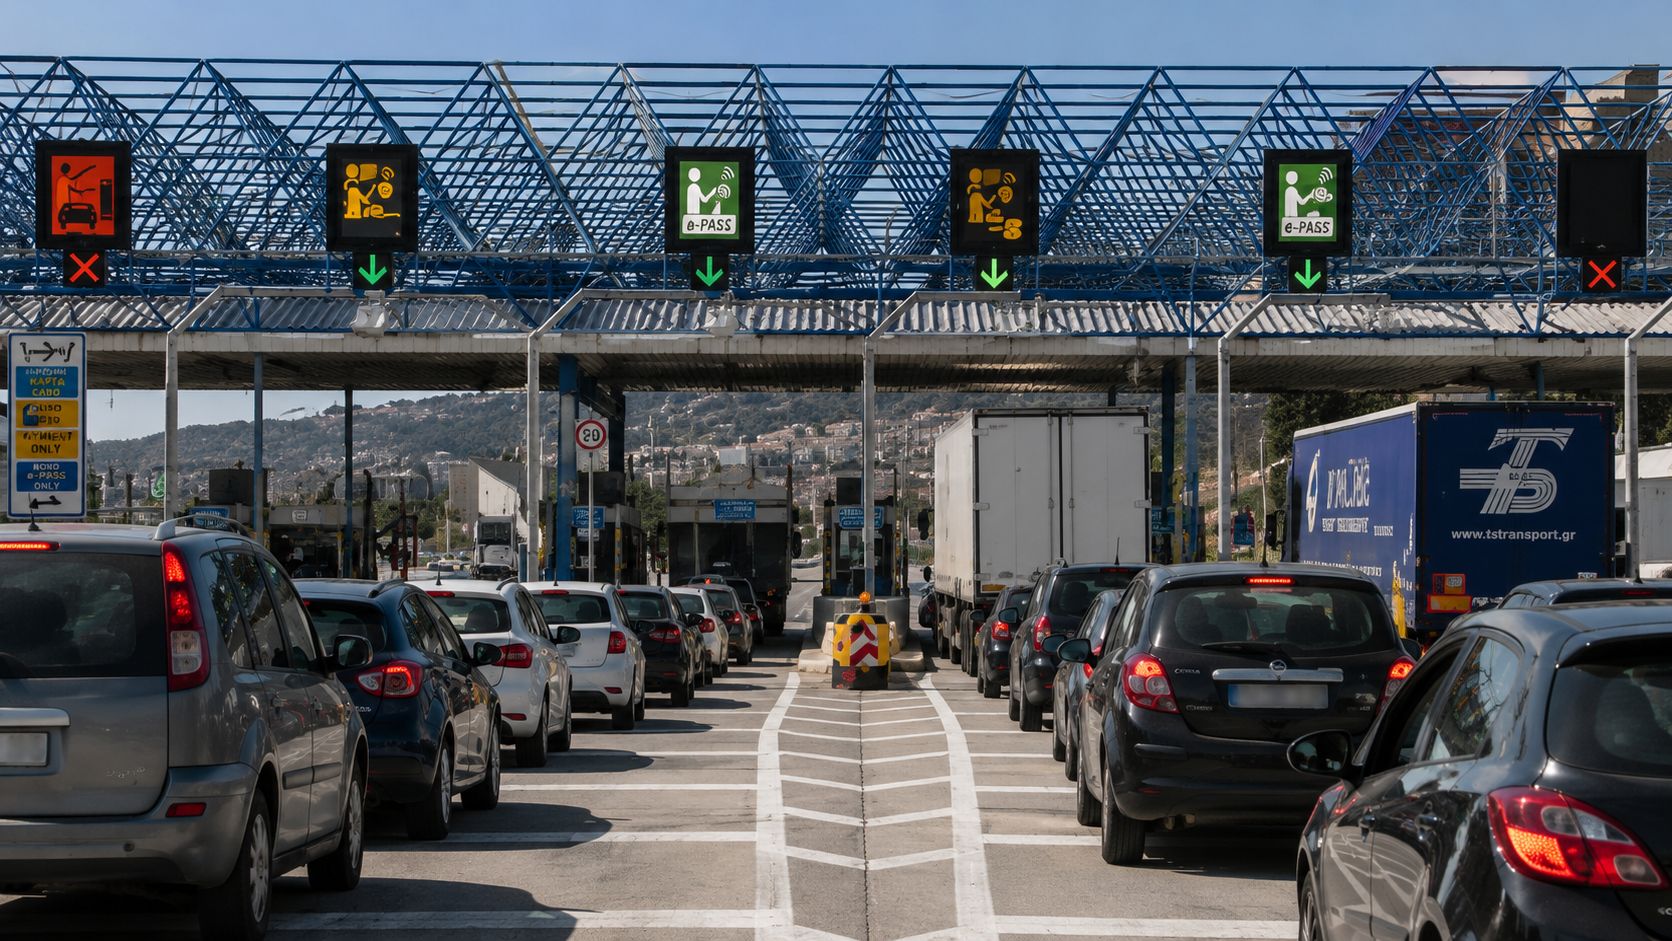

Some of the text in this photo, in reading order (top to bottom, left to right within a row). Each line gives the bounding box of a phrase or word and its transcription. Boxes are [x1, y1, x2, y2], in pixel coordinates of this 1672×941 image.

[687, 218, 732, 232] e-PASS
[1285, 221, 1331, 234] e-PASS
[31, 444, 61, 454] ONLY
[34, 482, 60, 490] ONLY
[1451, 529, 1576, 542] www.tstransport.gr
